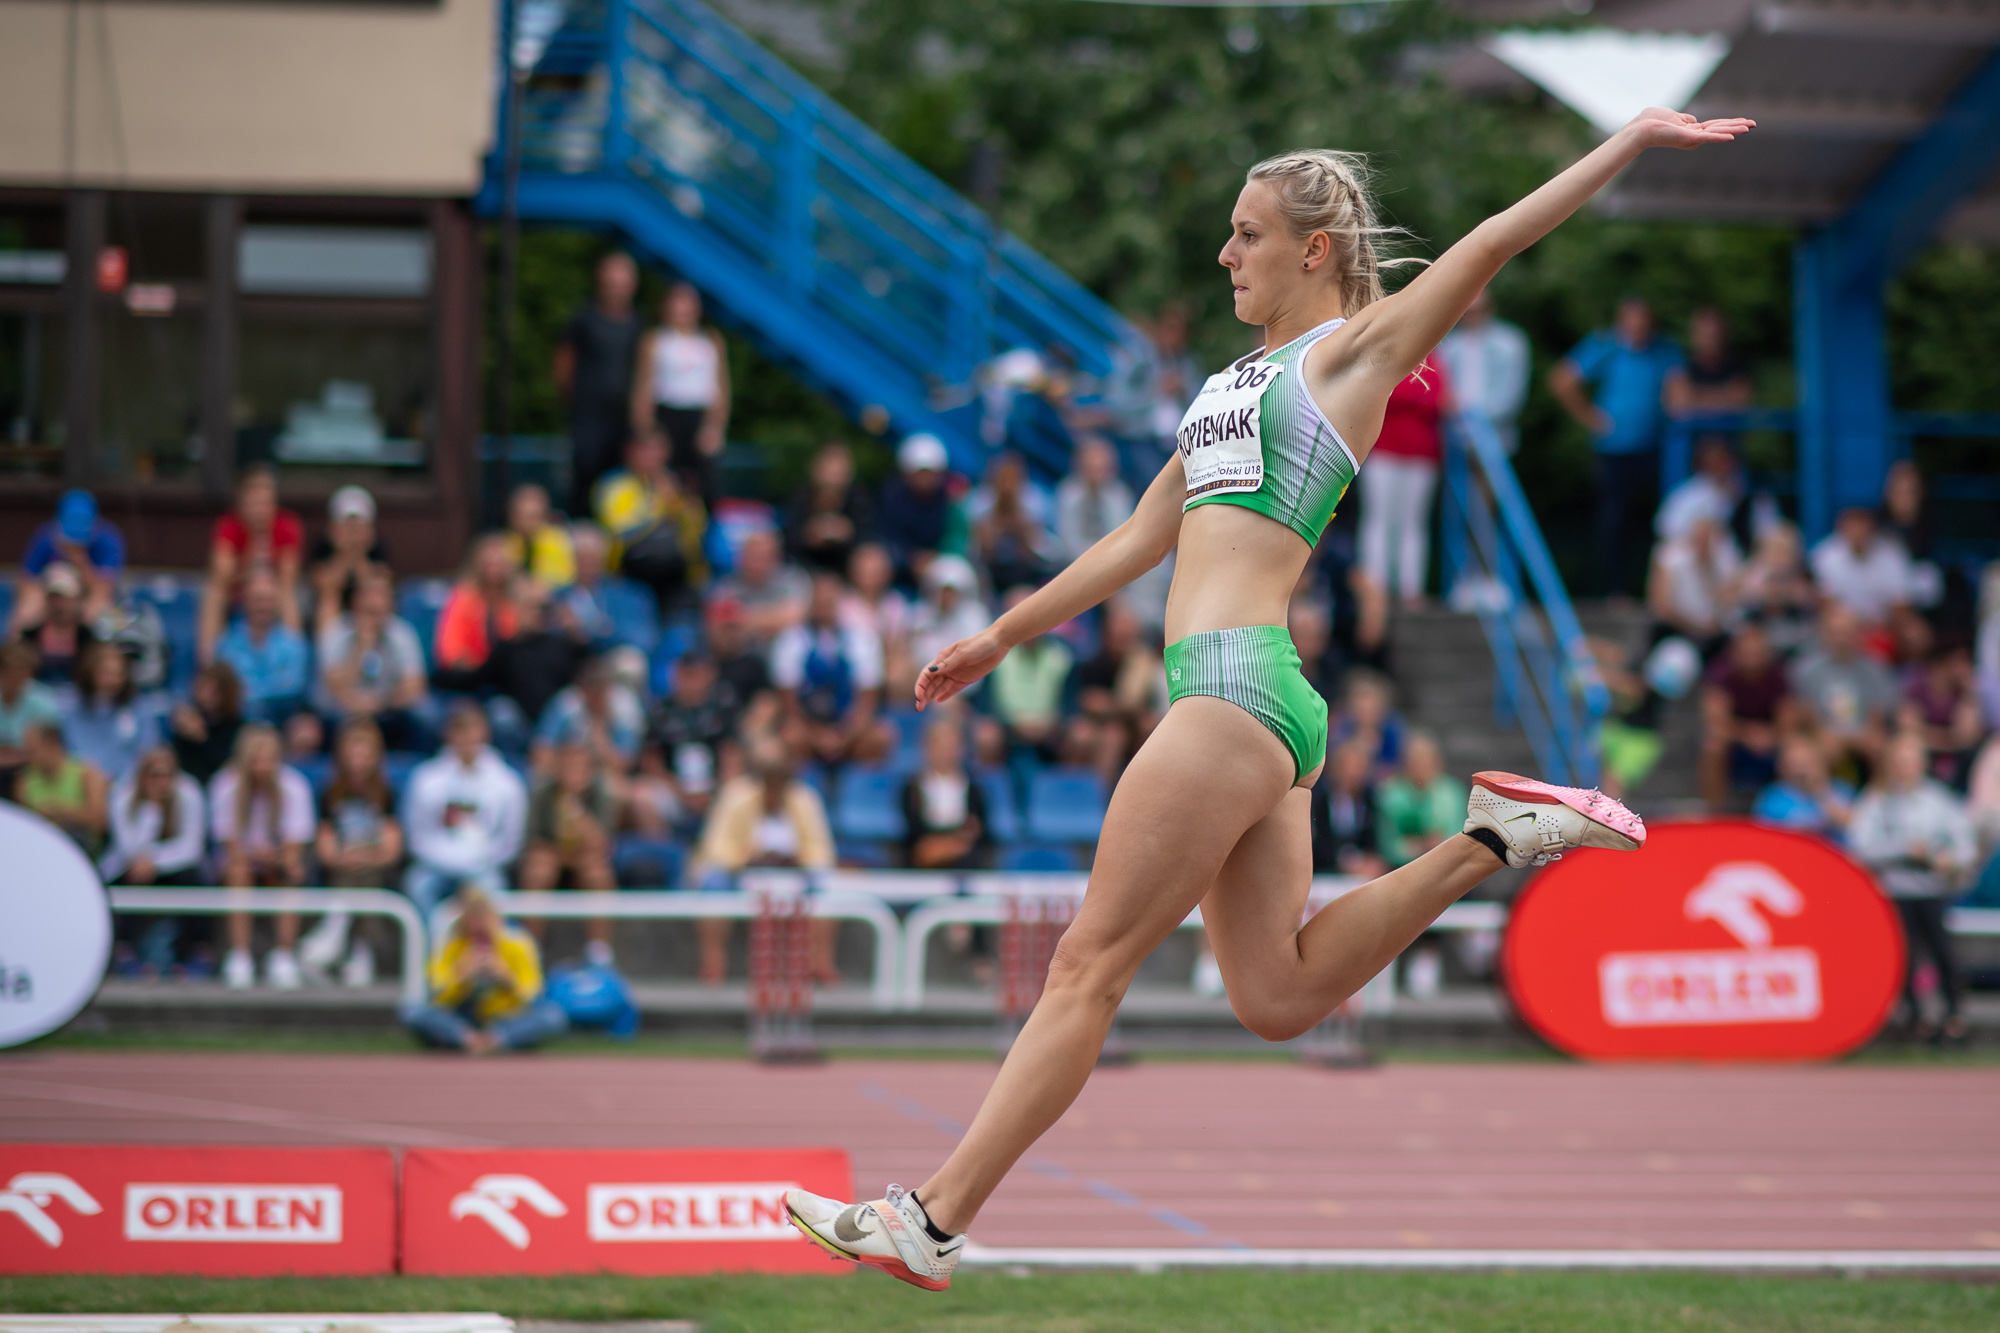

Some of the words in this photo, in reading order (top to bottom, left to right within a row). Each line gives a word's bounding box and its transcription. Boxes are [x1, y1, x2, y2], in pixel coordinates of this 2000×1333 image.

[1178, 408, 1255, 460] KOPIENIAK
[1245, 465, 1261, 475] U18
[141, 1196, 322, 1231] ORLEN
[606, 1197, 783, 1229] ORLEN
[875, 1204, 905, 1231] NIKE
